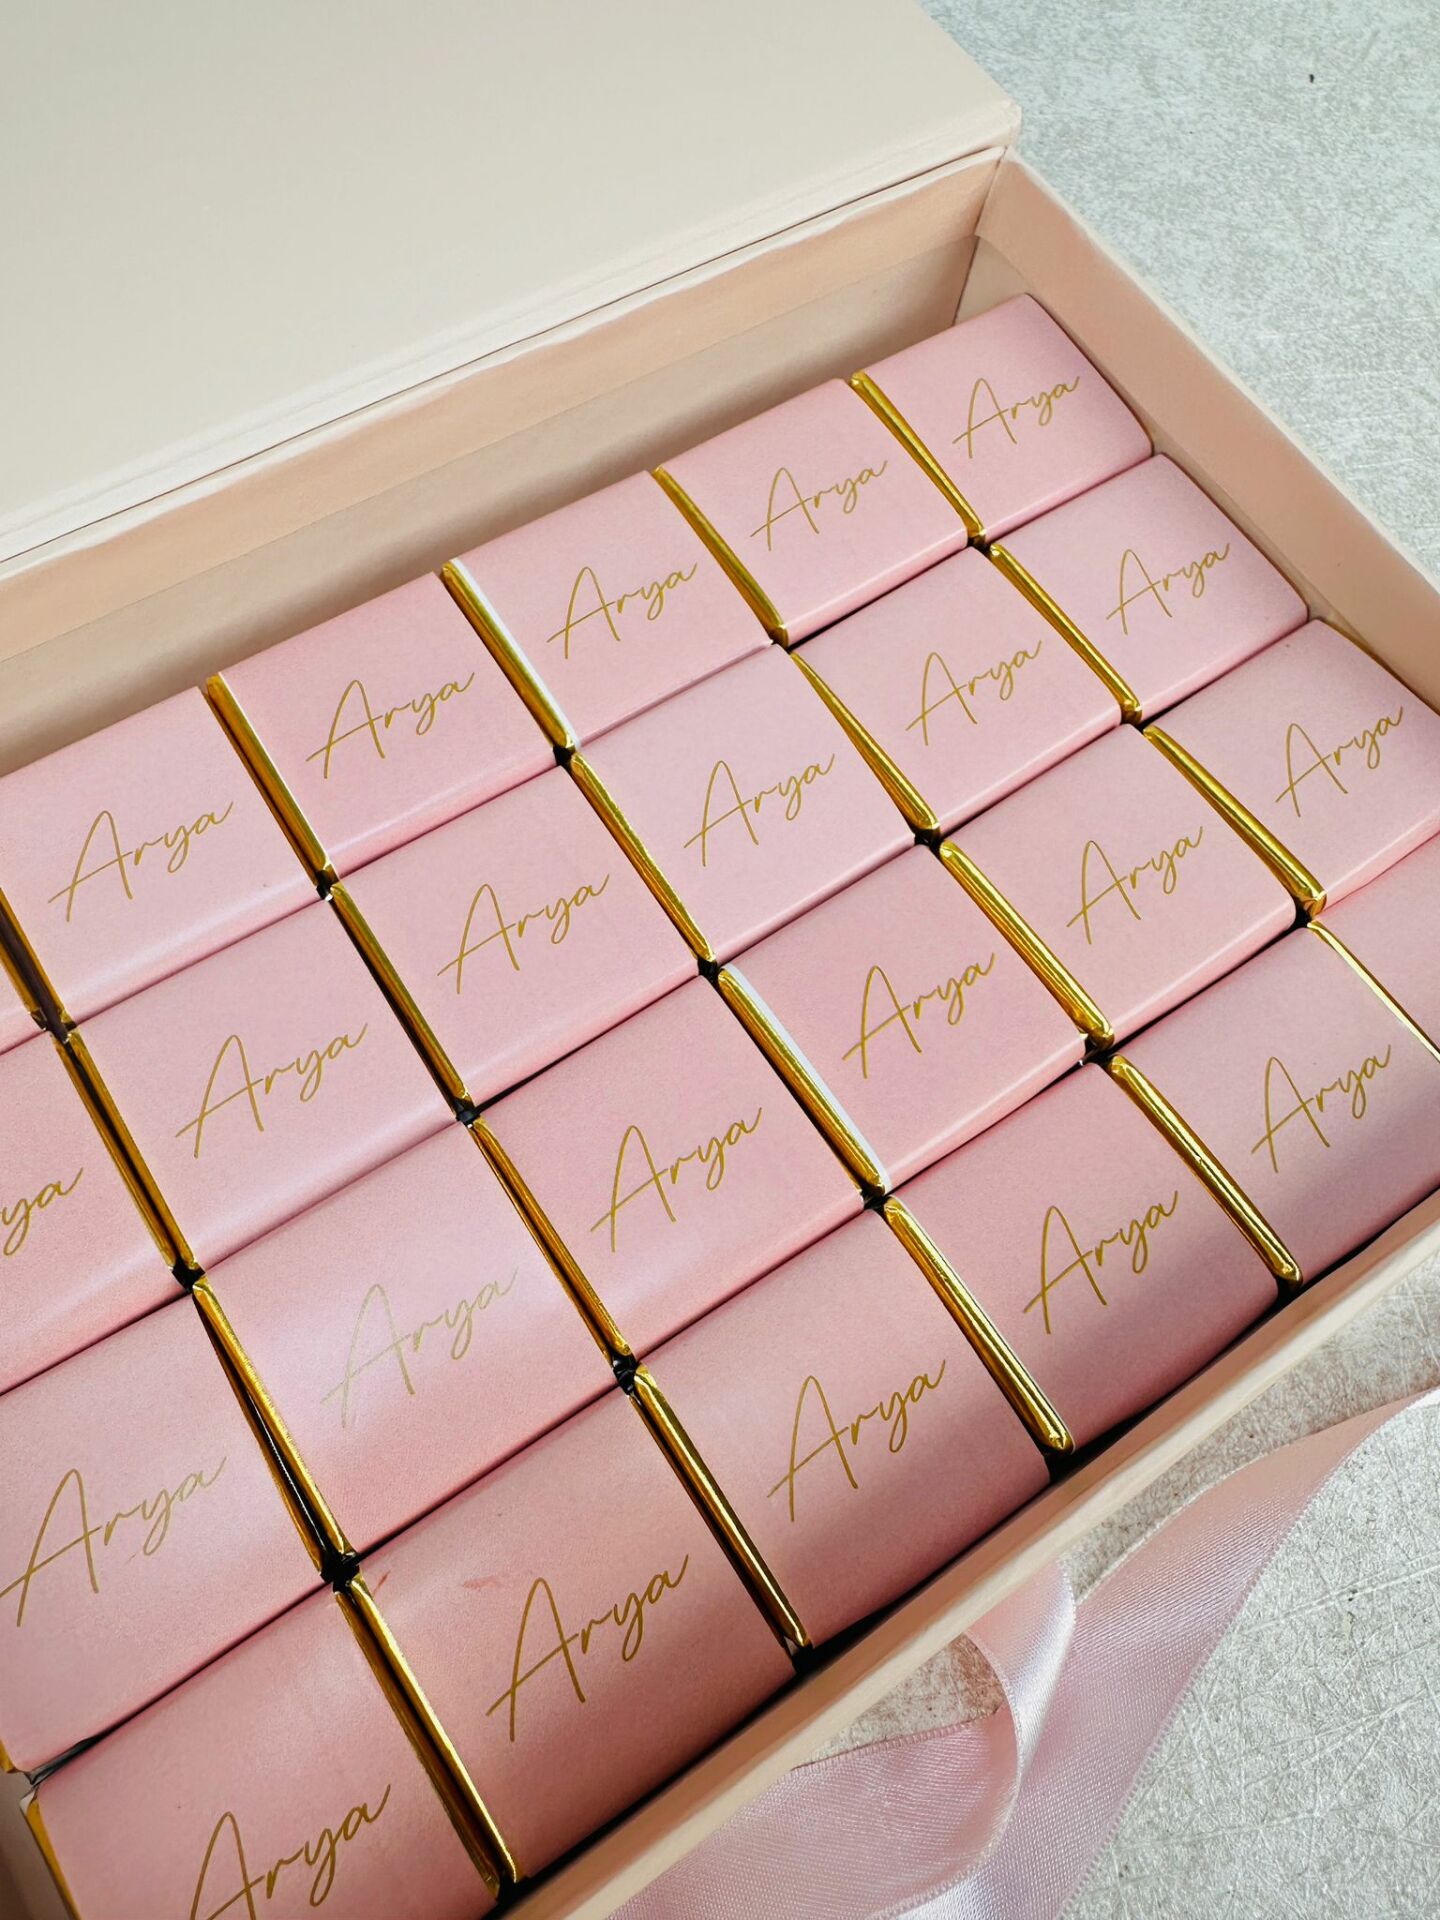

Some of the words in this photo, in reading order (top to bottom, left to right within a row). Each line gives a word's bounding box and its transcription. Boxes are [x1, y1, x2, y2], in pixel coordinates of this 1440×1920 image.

[953, 376, 1081, 458] Arya
[750, 461, 890, 551] Arya
[547, 562, 699, 660] Arya
[1106, 546, 1229, 635] Arya
[304, 673, 475, 781] Arya
[904, 637, 1043, 746] Arya
[680, 753, 836, 867] Arya
[1273, 707, 1404, 816] Arya
[48, 801, 235, 922] Arya
[1064, 825, 1205, 945] Arya
[435, 873, 610, 994] Arya
[839, 949, 999, 1082] Arya
[173, 1023, 369, 1159] Arya
[1249, 1044, 1392, 1172] Arya
[0, 1167, 84, 1256] ya
[589, 1106, 764, 1255] Arya
[1021, 1189, 1181, 1335] Arya
[319, 1266, 518, 1428] Arya
[765, 1358, 946, 1521] Arya
[0, 1456, 227, 1627] Arya
[485, 1553, 690, 1742] Arya
[190, 1783, 392, 1920] Arya
